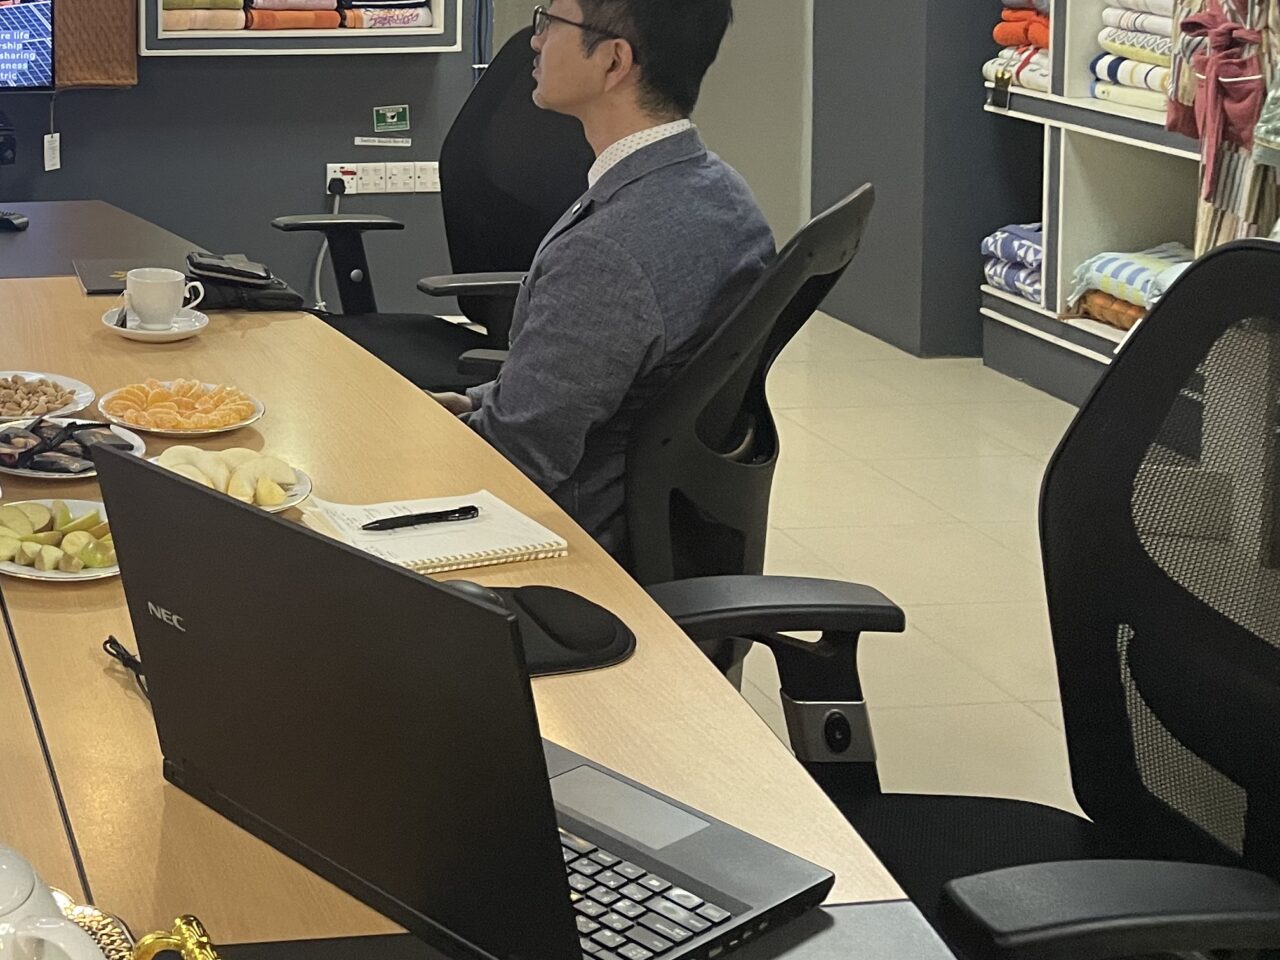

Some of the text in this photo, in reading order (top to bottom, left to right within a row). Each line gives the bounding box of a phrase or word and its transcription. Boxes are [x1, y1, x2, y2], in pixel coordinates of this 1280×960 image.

[14, 31, 30, 39] life
[0, 51, 36, 61] sharing
[147, 601, 186, 632] NEC
